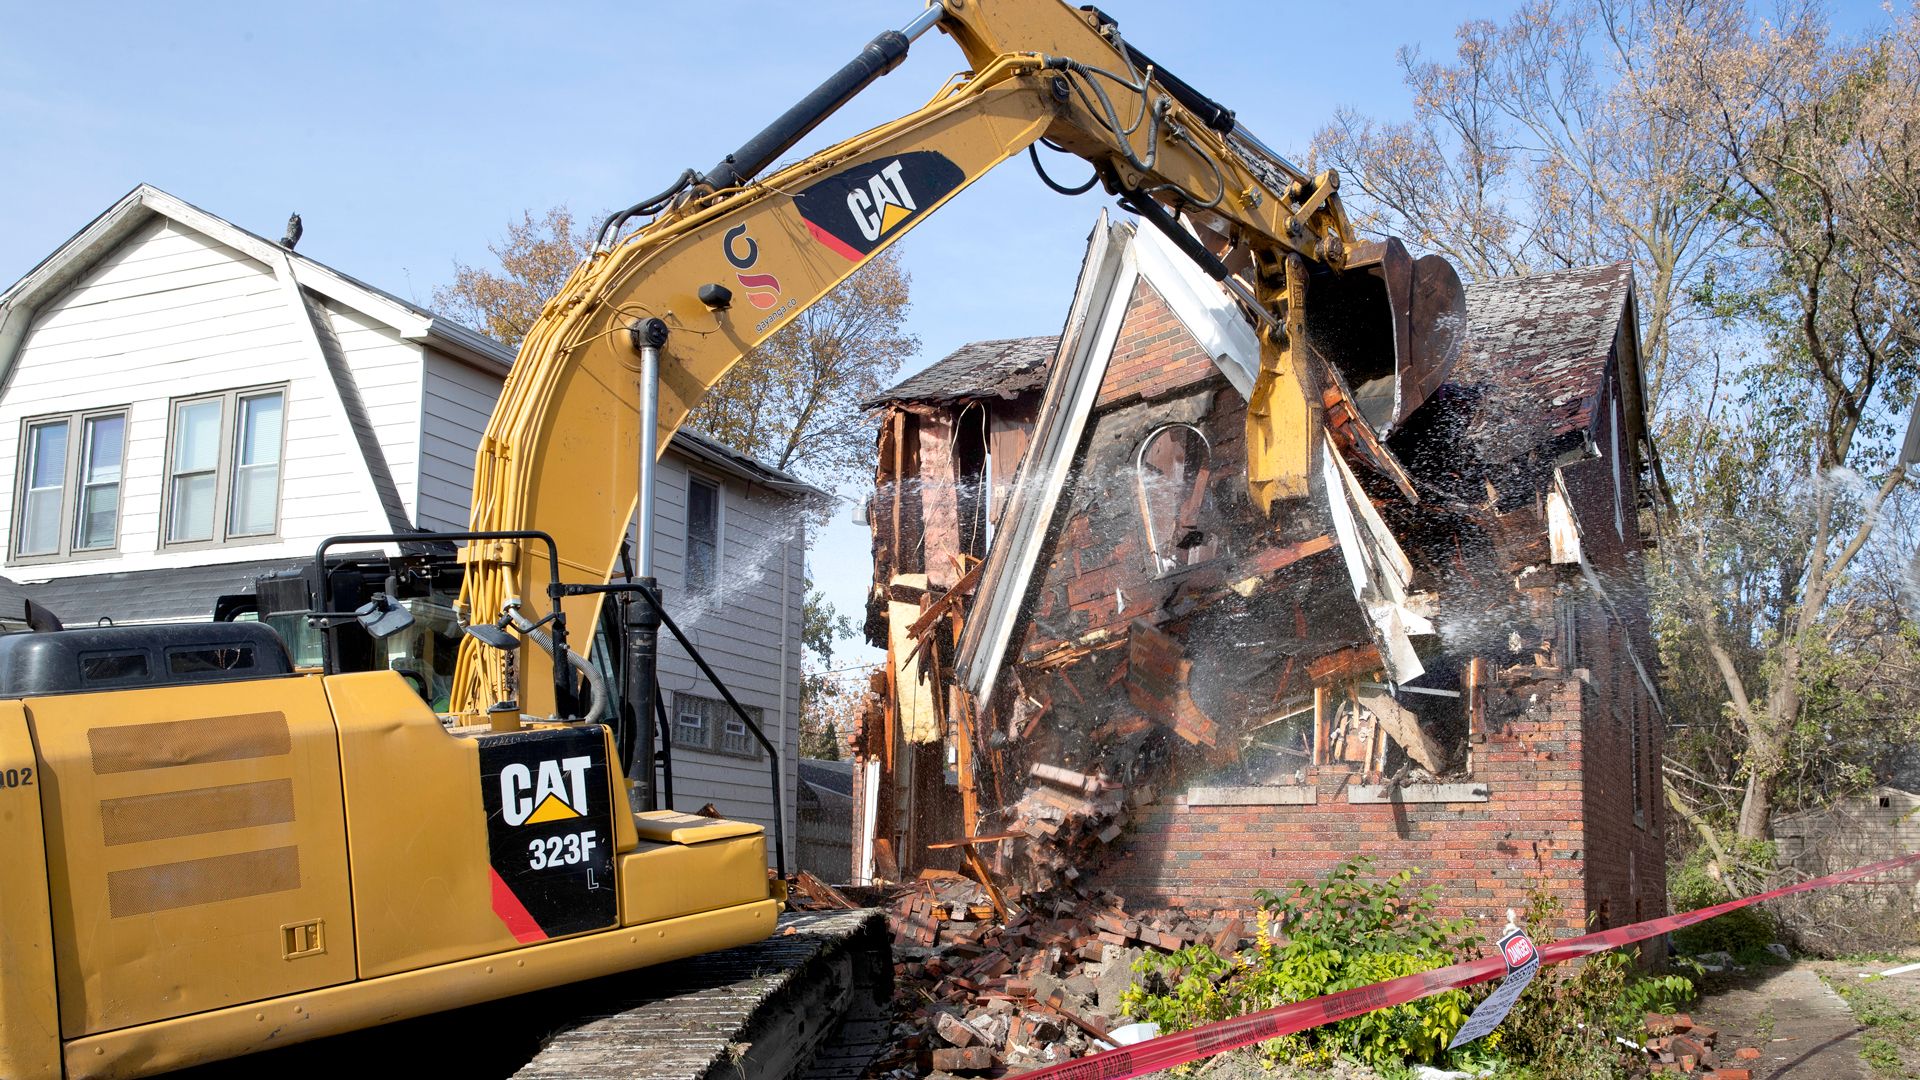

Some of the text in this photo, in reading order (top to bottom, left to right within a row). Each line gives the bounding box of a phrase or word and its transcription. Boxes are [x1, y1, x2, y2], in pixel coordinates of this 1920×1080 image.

[847, 159, 917, 241] CAT
[755, 298, 797, 334] gayanga.co
[500, 755, 592, 827] CAT
[528, 830, 597, 871] 323F
[586, 868, 600, 890] L
[1507, 938, 1531, 964] DANGER
